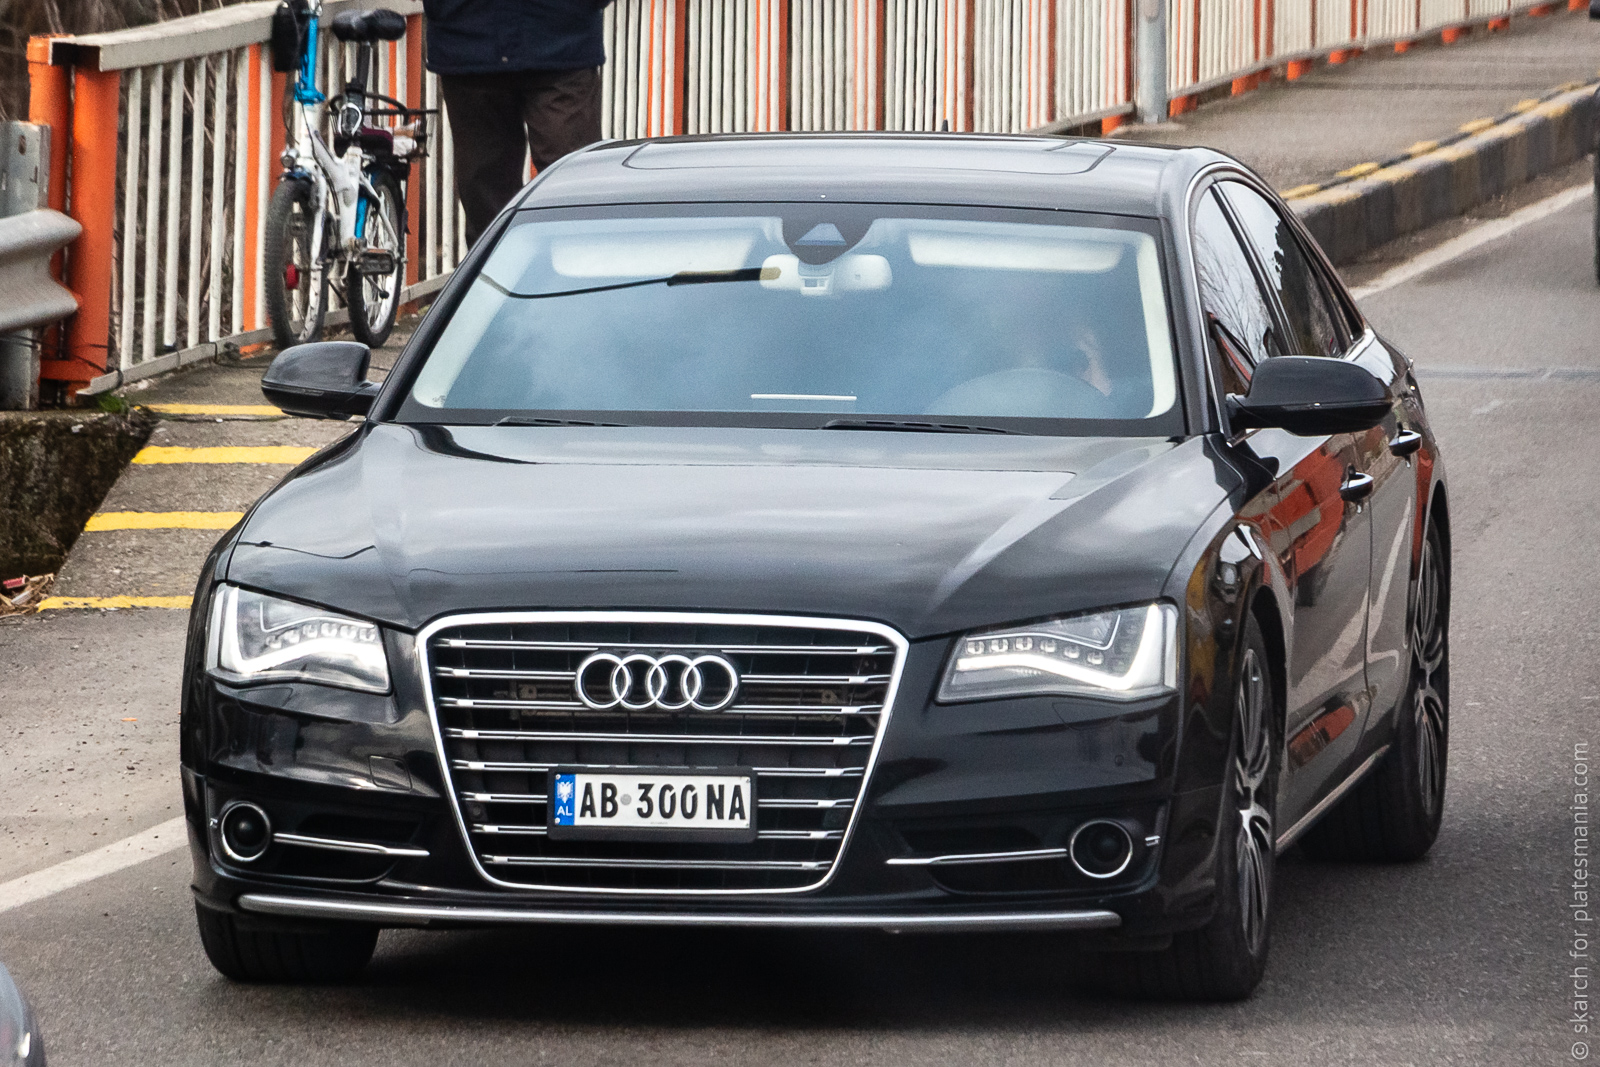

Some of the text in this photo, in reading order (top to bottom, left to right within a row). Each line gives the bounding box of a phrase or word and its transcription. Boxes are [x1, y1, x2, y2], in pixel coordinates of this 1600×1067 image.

[557, 806, 573, 816] AL
[579, 782, 746, 820] AB 300 NA
